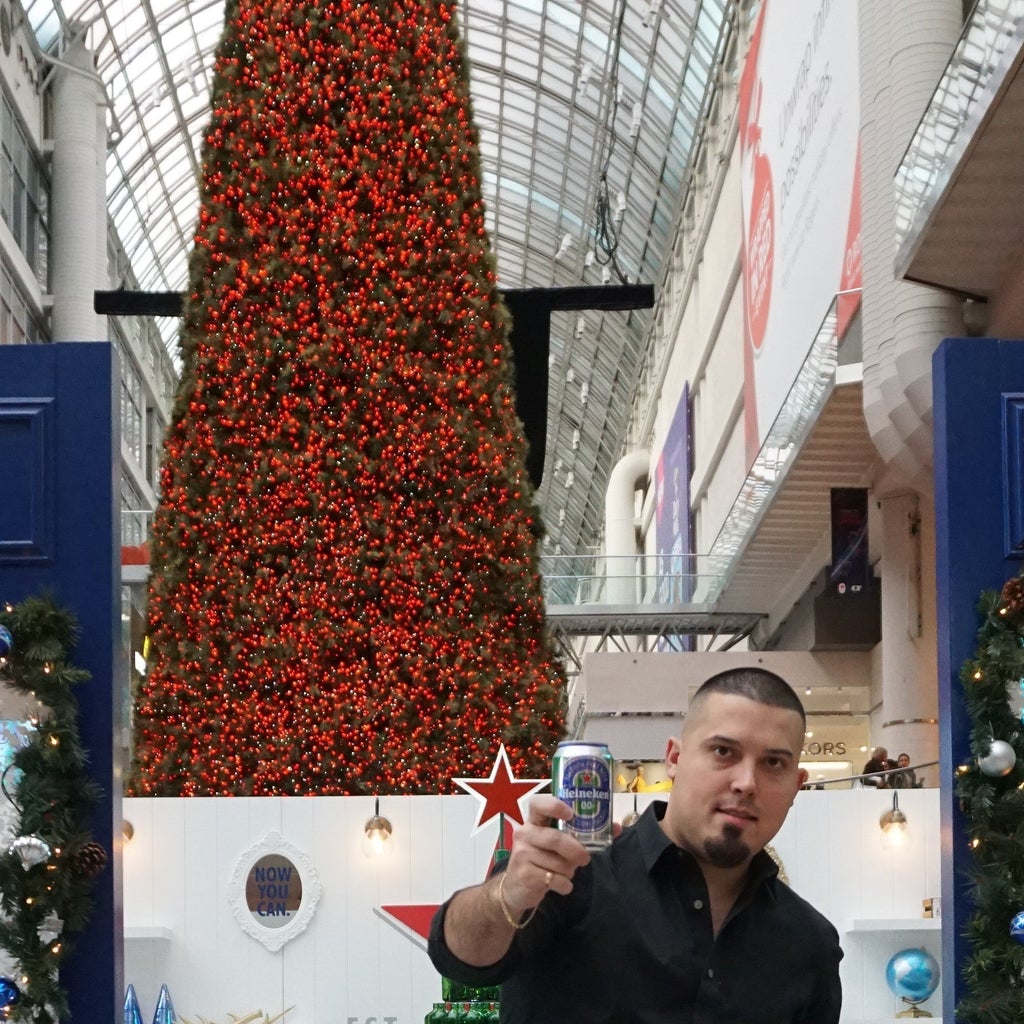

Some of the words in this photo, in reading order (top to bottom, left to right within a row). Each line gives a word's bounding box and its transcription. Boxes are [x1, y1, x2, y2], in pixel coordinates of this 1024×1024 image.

[779, 41, 811, 147] Unwrap
[562, 788, 609, 800] Heineken
[255, 867, 292, 882] NOW
[258, 885, 288, 899] YOU
[257, 901, 290, 917] CAN.
